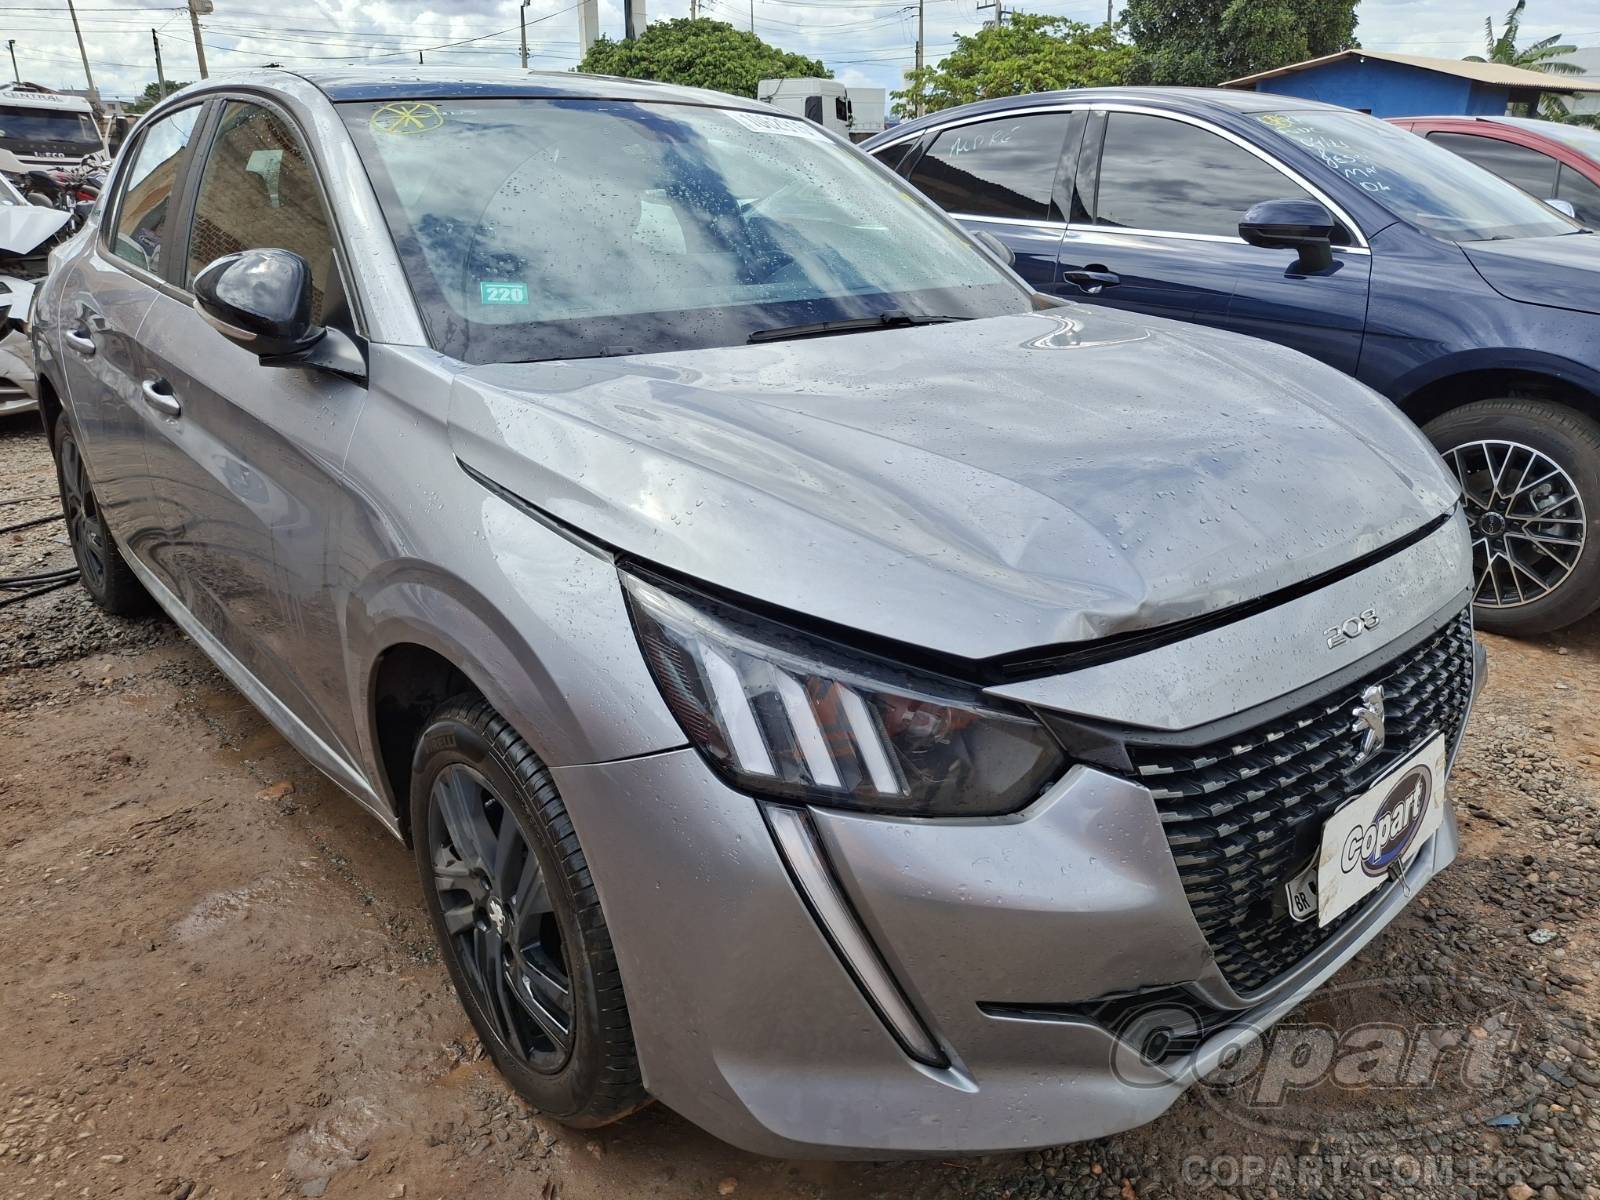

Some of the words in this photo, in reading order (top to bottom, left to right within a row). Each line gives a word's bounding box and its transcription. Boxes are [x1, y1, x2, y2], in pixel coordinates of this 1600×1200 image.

[486, 287, 524, 302] 220
[1323, 608, 1380, 650] 208
[1340, 774, 1424, 875] Copart
[1294, 892, 1311, 913] BR
